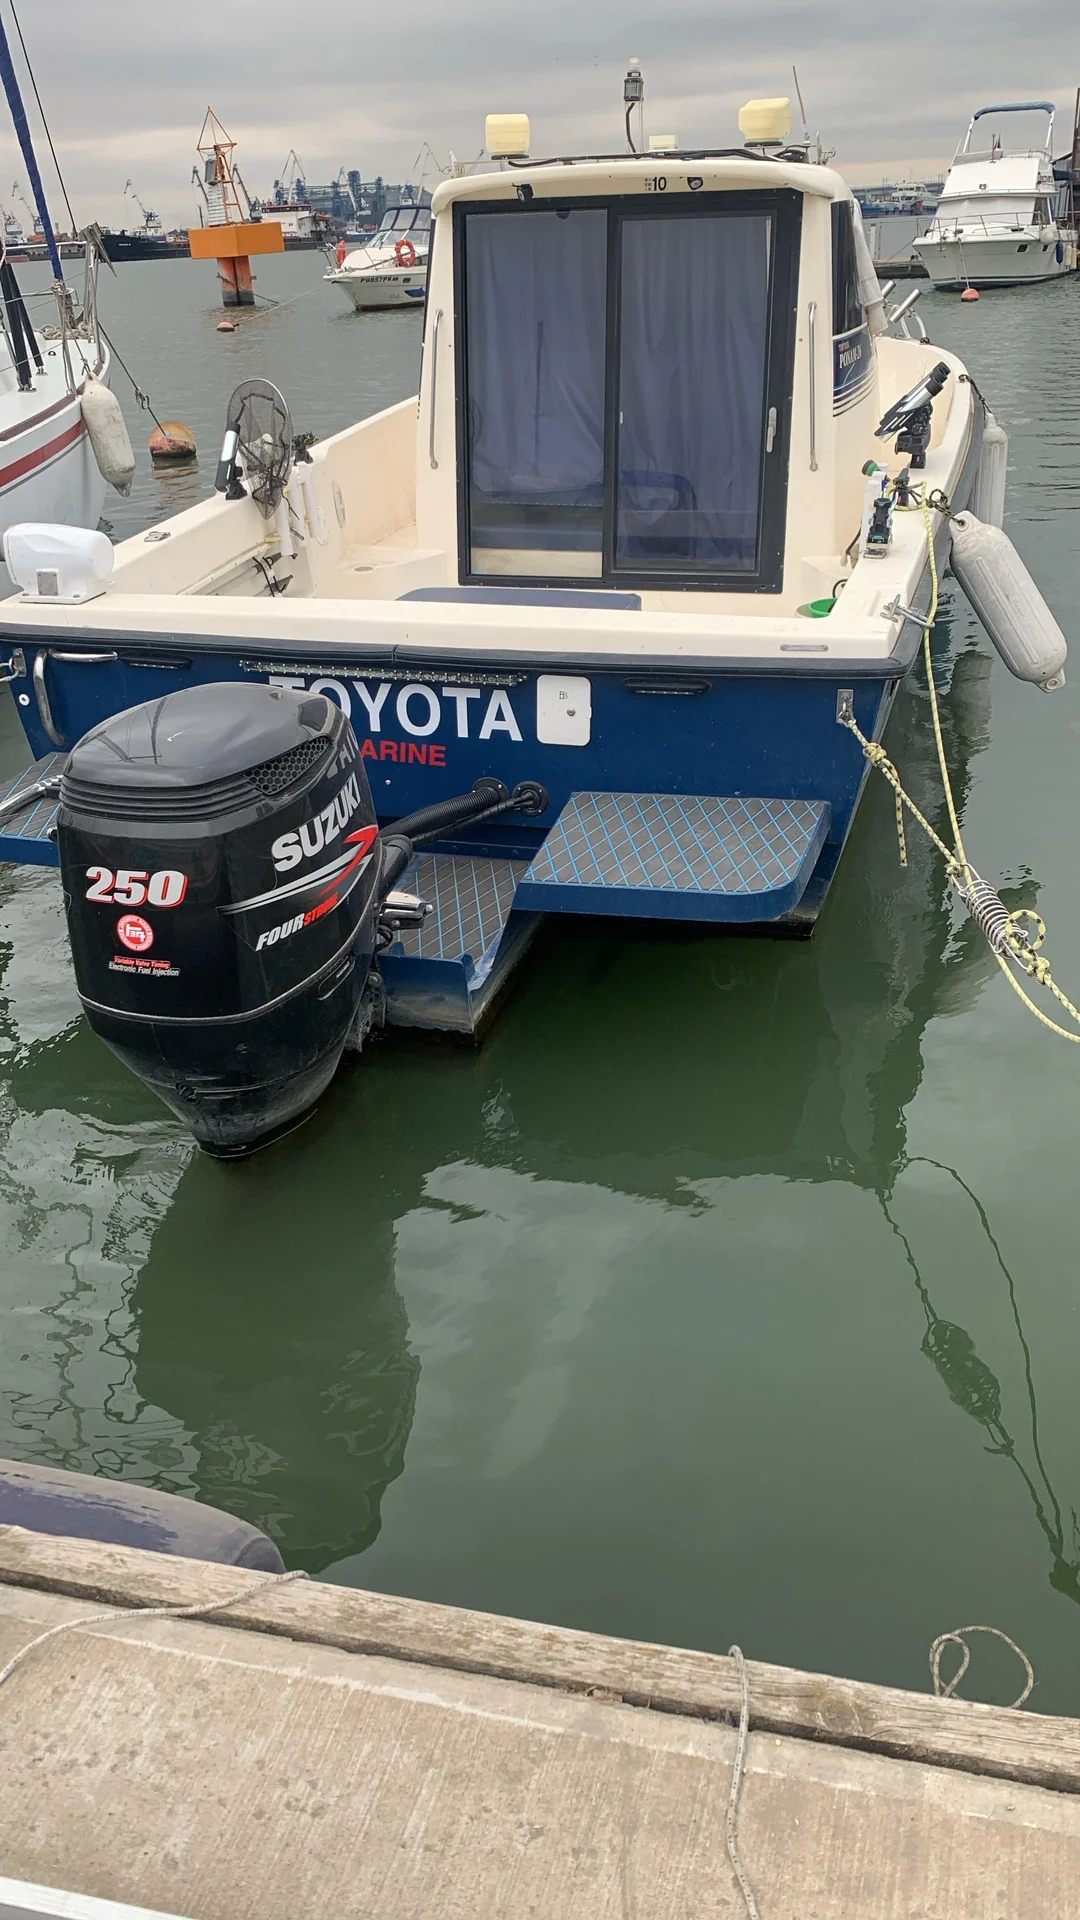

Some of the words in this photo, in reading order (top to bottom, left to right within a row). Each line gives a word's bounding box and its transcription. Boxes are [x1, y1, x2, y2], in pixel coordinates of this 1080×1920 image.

[652, 176, 667, 191] 10
[360, 738, 446, 767] ARINE
[271, 771, 362, 873] SUZUKI
[85, 866, 188, 908] 250
[137, 966, 151, 974] Fuel
[152, 967, 179, 977] Injection
